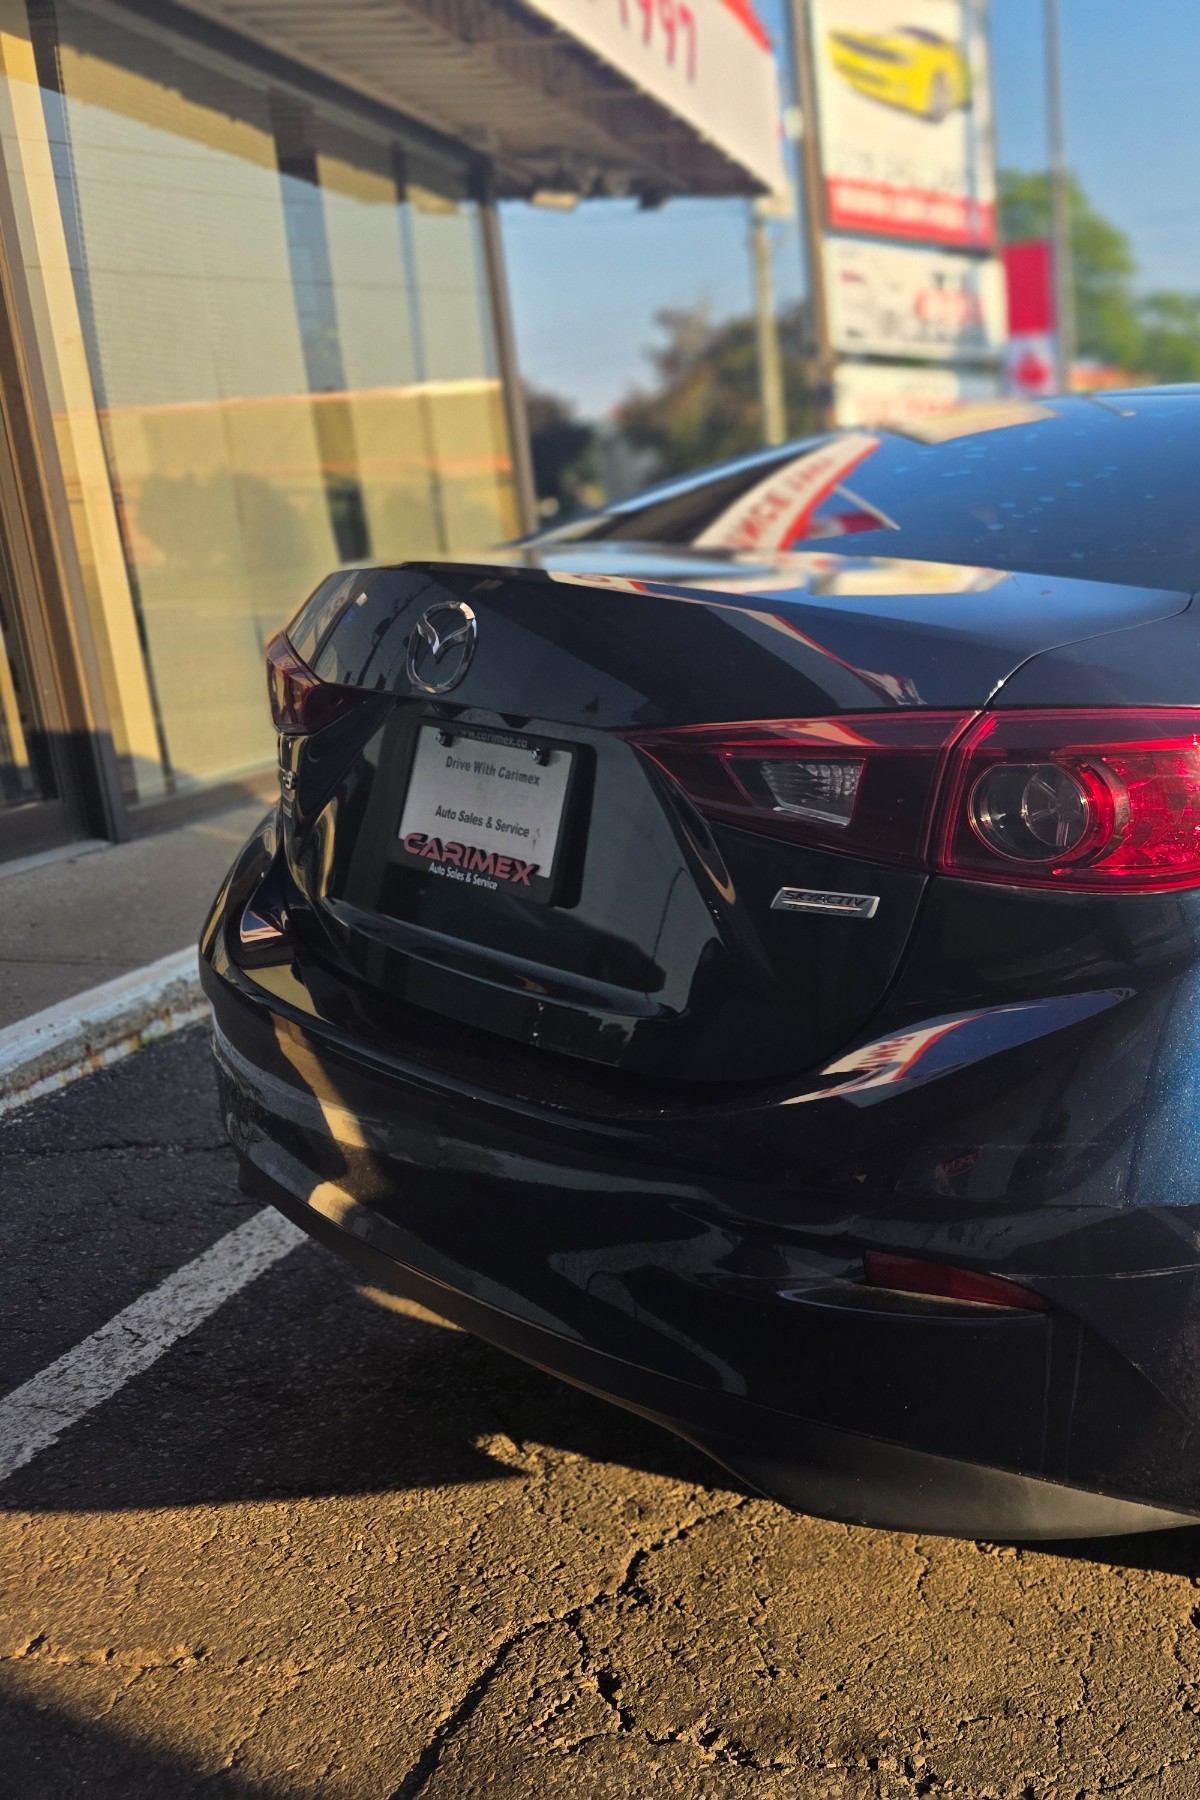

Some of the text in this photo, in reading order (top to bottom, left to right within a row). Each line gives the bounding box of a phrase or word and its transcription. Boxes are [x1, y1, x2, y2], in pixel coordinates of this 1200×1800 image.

[445, 756, 541, 785] Drive With Carimex
[435, 805, 530, 837] Auto Sales & Service
[403, 832, 533, 886] CARIMEX
[429, 862, 446, 875] Auto
[446, 866, 466, 881] Sales
[473, 874, 499, 891] Service
[781, 891, 868, 907] SKYACTIV
